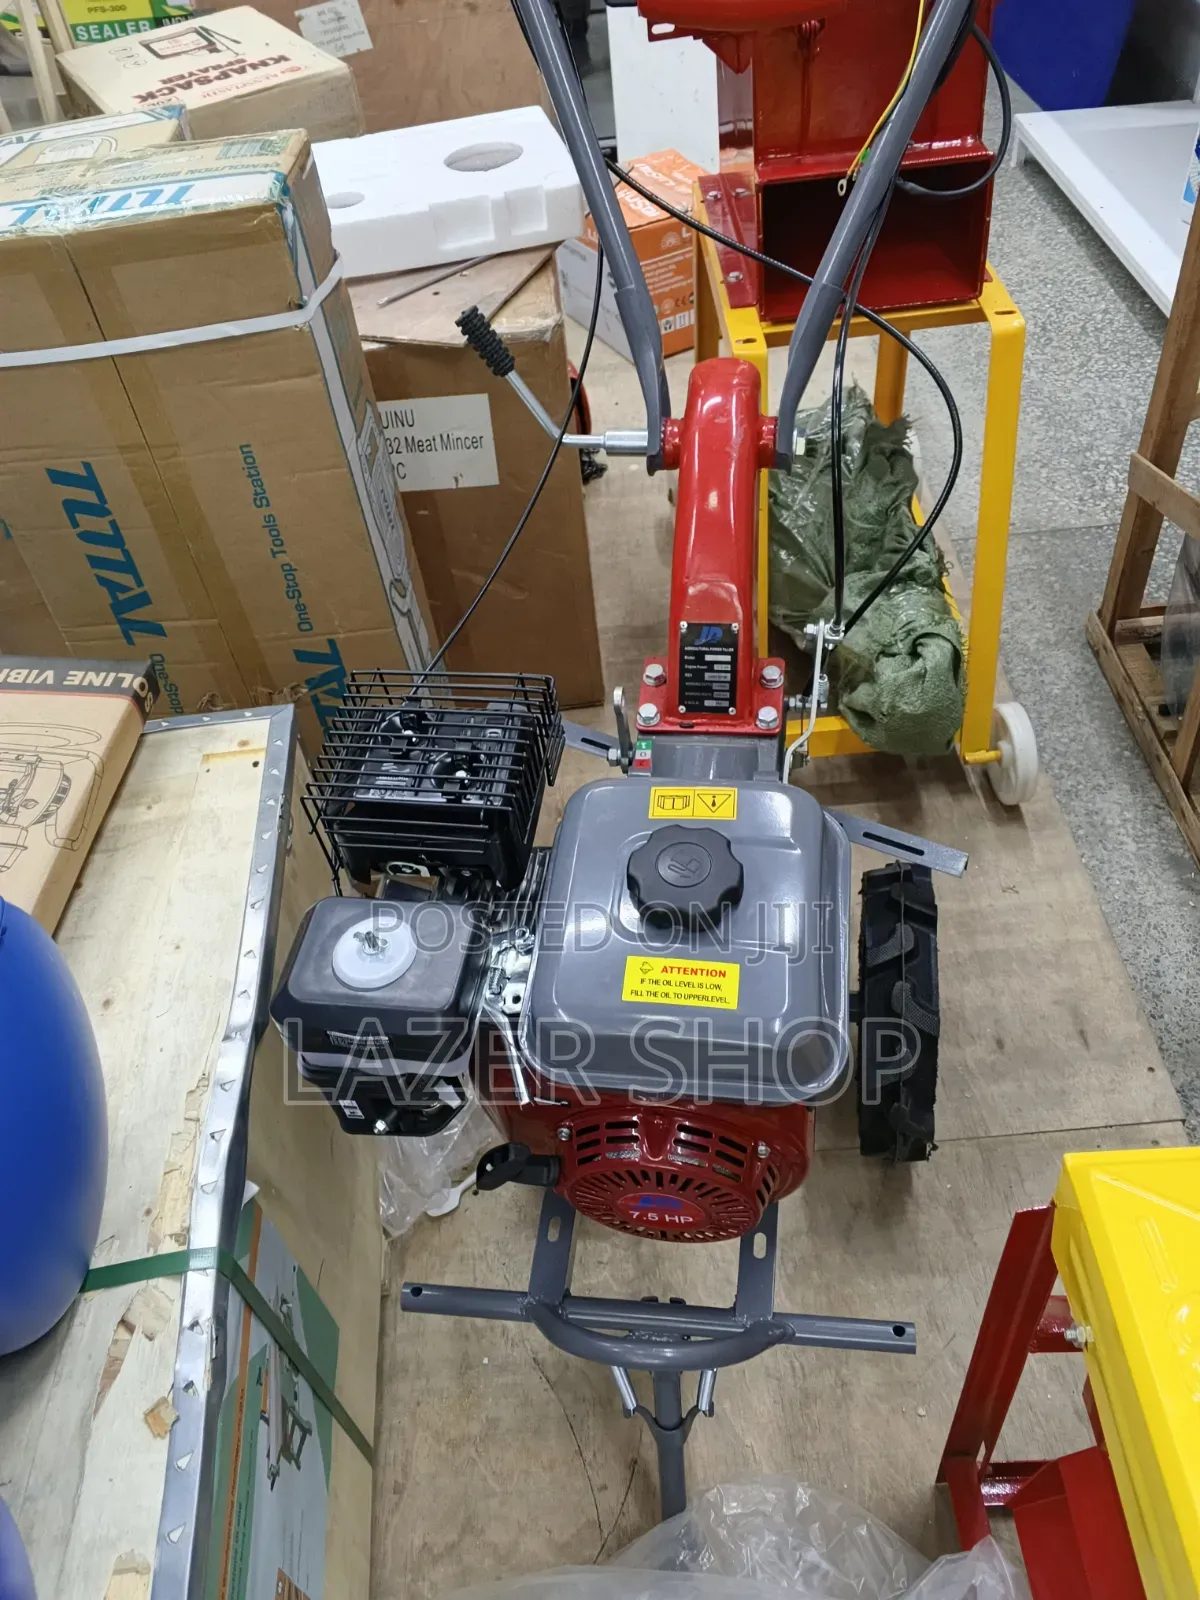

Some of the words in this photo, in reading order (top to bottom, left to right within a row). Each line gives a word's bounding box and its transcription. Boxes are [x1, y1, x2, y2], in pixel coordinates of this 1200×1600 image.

[75, 20, 151, 41] SEALER
[133, 55, 292, 104] KNAPSACK
[159, 58, 248, 85] SPRAYER
[110, 171, 184, 185] BREAKER
[405, 436, 438, 453] Meat
[440, 433, 484, 452] Mincer
[239, 443, 271, 509] Station
[262, 513, 288, 559] Tools
[44, 461, 168, 646] TOTAL
[280, 563, 313, 633] One-Stop
[661, 965, 727, 978] ATTENTION
[630, 989, 644, 997] FILL
[646, 990, 659, 998] THE
[660, 991, 672, 999] OIL
[648, 978, 660, 986] THE
[675, 980, 695, 989] LEVEL
[629, 1210, 658, 1222] 7.5
[664, 1213, 694, 1224] HP
